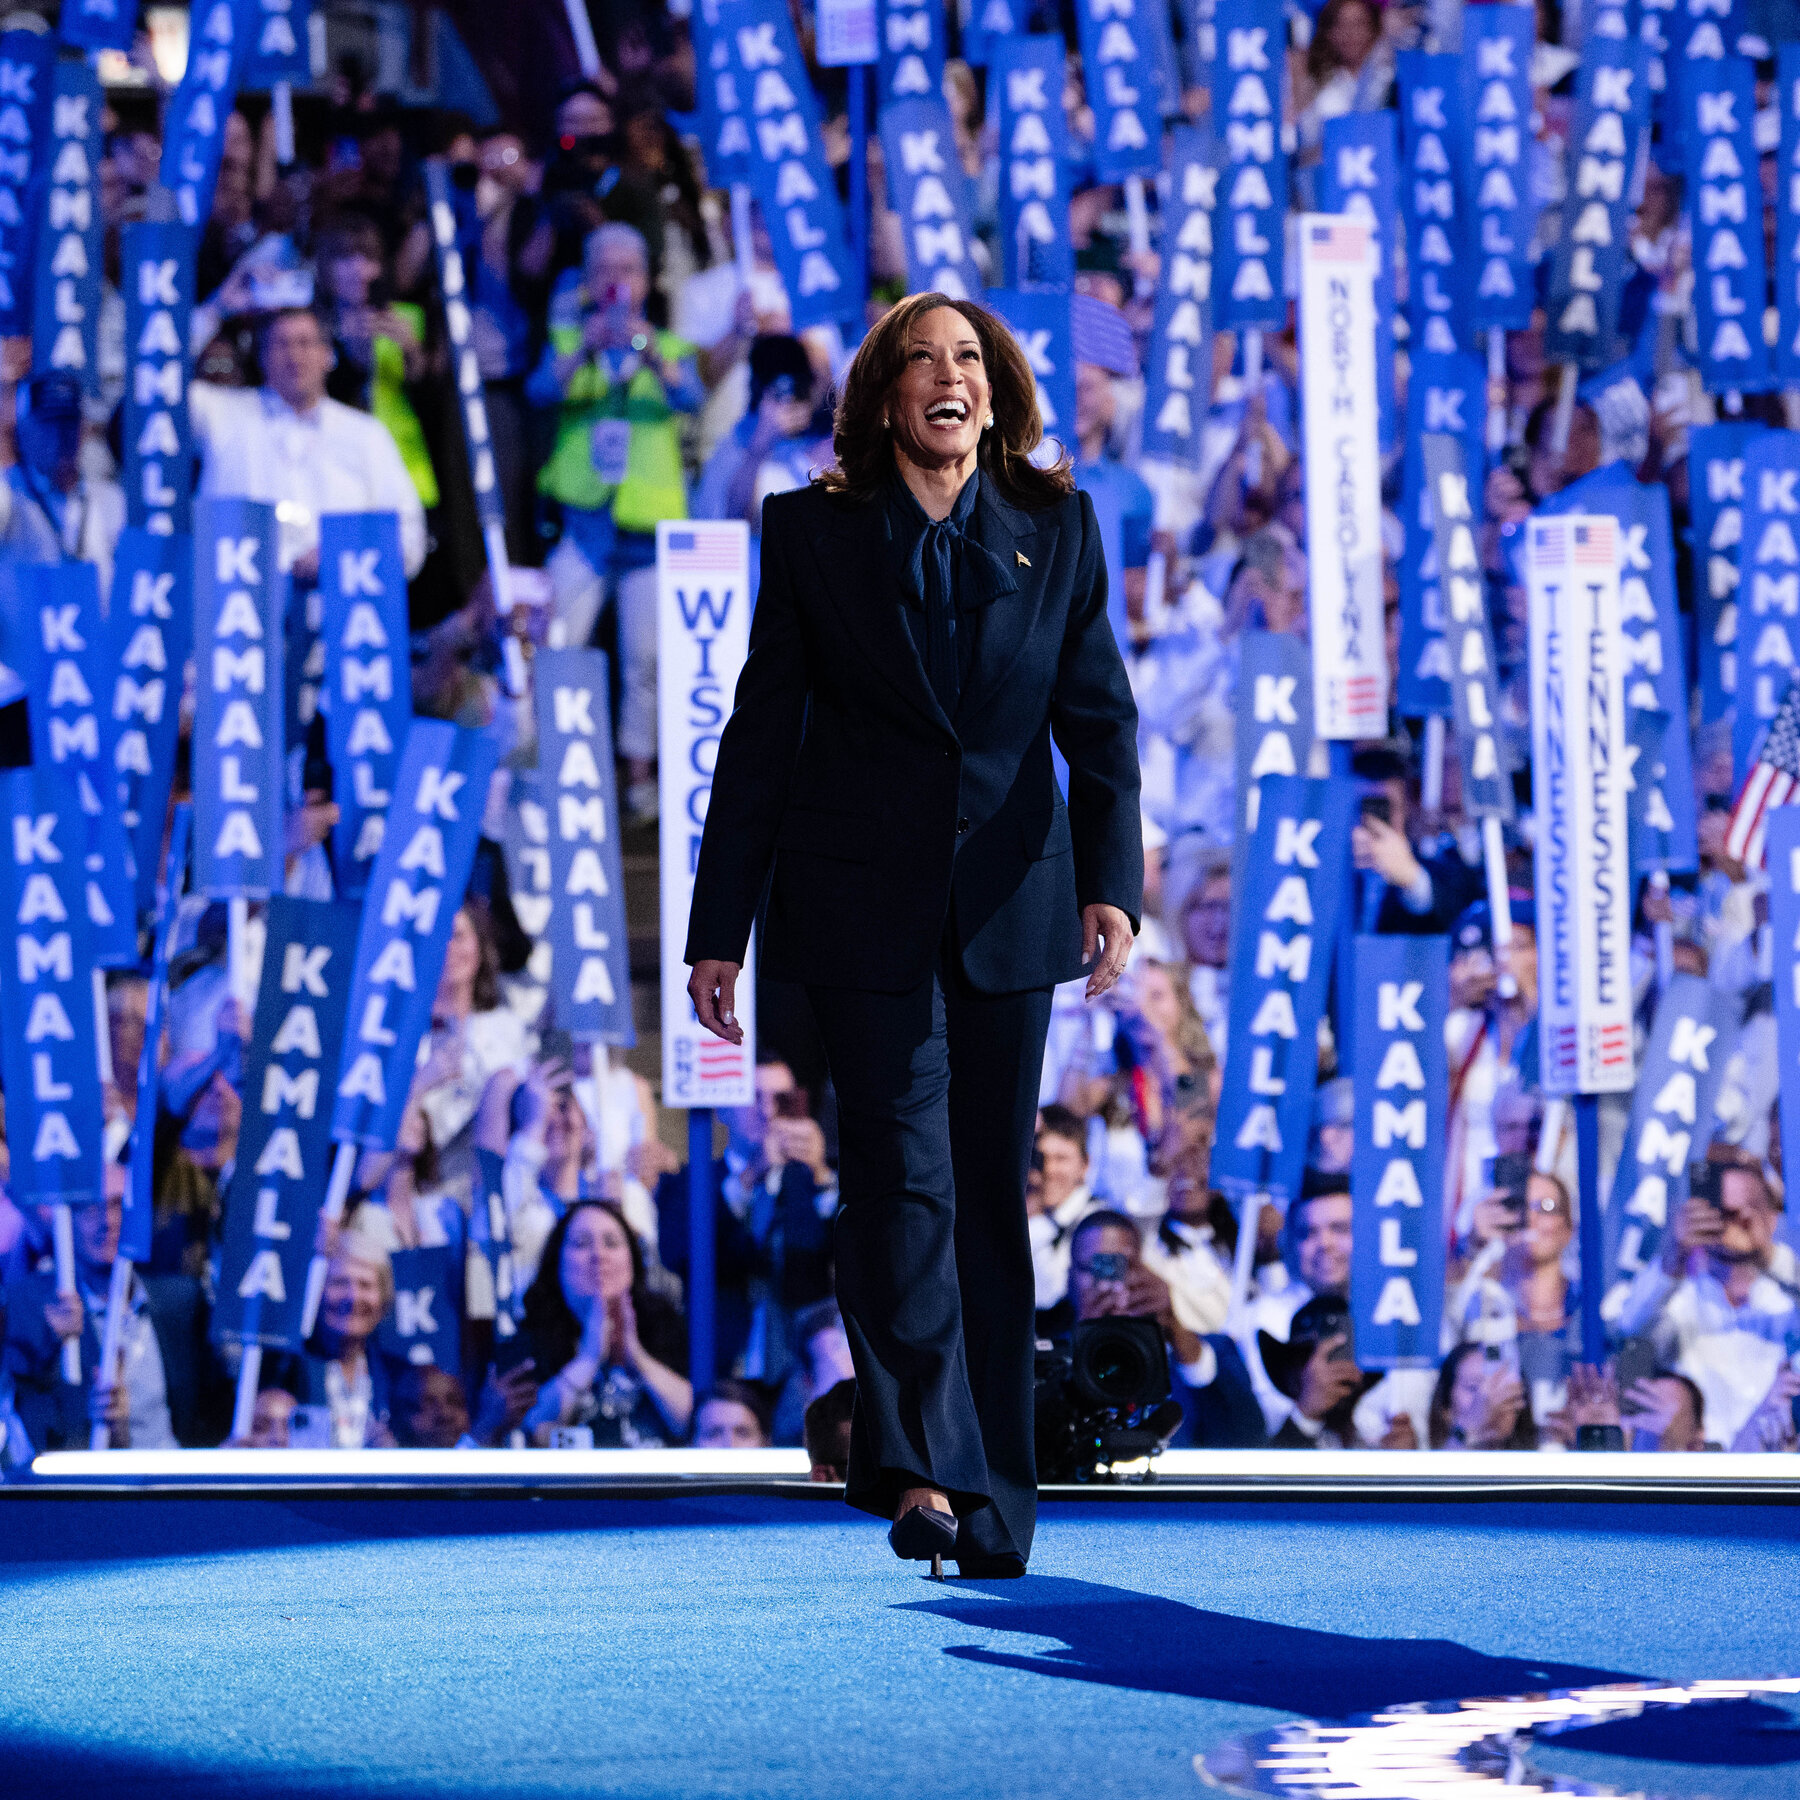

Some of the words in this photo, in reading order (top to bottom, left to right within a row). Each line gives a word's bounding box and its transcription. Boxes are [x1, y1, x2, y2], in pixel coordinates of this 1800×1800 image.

[737, 22, 840, 297] KAMALA
[1008, 67, 1056, 244] KAMA
[1090, 0, 1147, 151] ALA
[1226, 26, 1273, 300] KAMALA
[1475, 36, 1519, 298] KAMALA
[1559, 65, 1633, 336] KAMALA
[51, 93, 92, 369] KAMALA
[901, 130, 967, 299] KAMA
[1157, 162, 1219, 438] KAMALA
[1411, 86, 1458, 354] KAMALA
[1697, 91, 1750, 362] KAMALA
[213, 536, 265, 859] KAMALA
[1543, 583, 1571, 1006] TENNESSEE
[1586, 581, 1613, 1004] TENNESSEE
[336, 765, 466, 1104] KAMALA
[553, 686, 616, 1004] KAMALA
[12, 813, 82, 1161] KAMALA
[238, 942, 333, 1303] KAMALA
[1235, 817, 1322, 1152] KAMALA
[1371, 981, 1427, 1326] KAMALA
